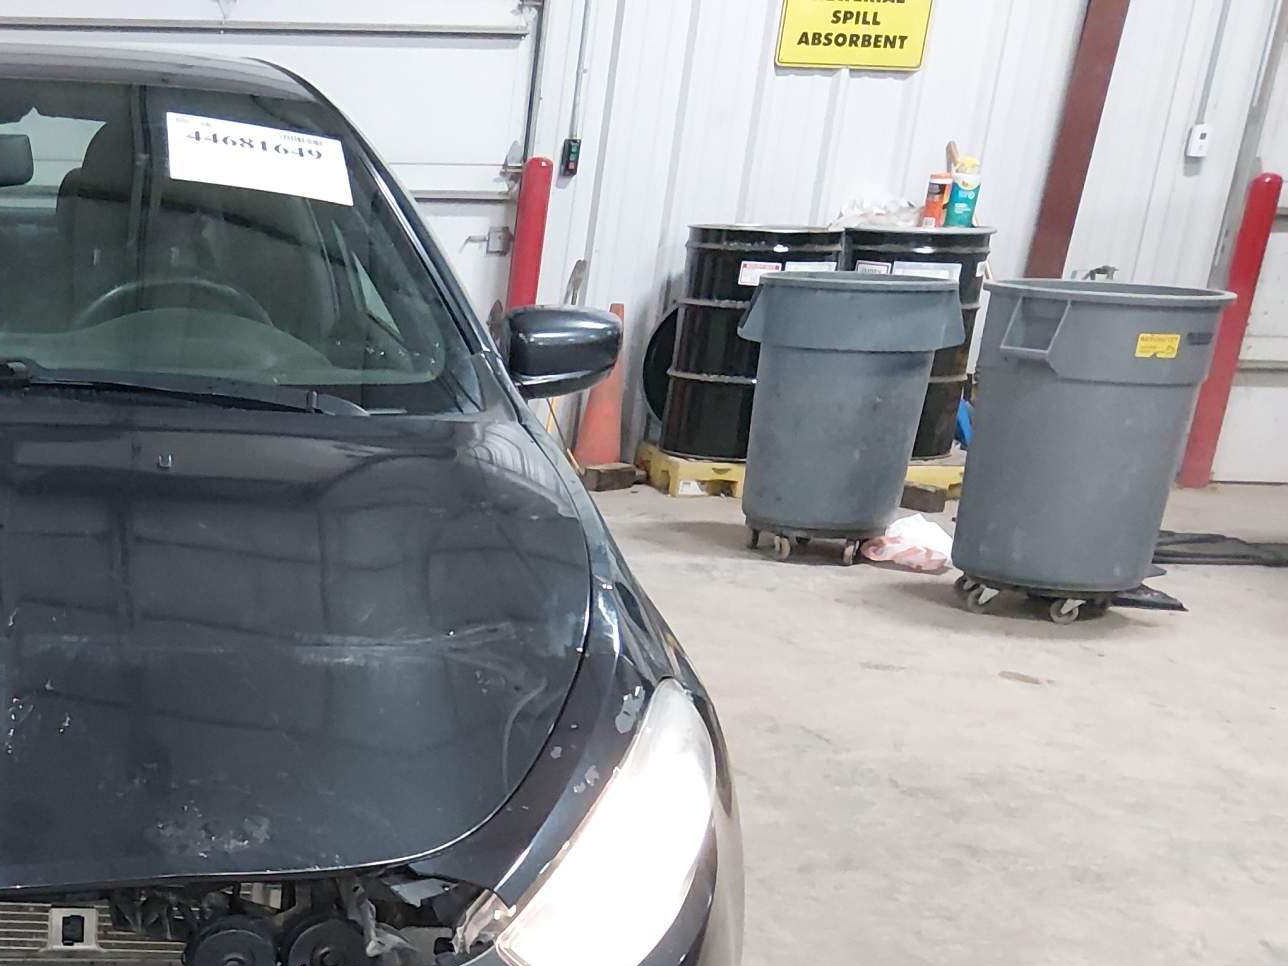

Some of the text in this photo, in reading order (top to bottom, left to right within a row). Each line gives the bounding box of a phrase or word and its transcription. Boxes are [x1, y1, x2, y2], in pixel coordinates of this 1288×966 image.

[831, 10, 881, 26] SPILL
[797, 32, 908, 49] ABSORBENT
[187, 131, 323, 160] 44681649
